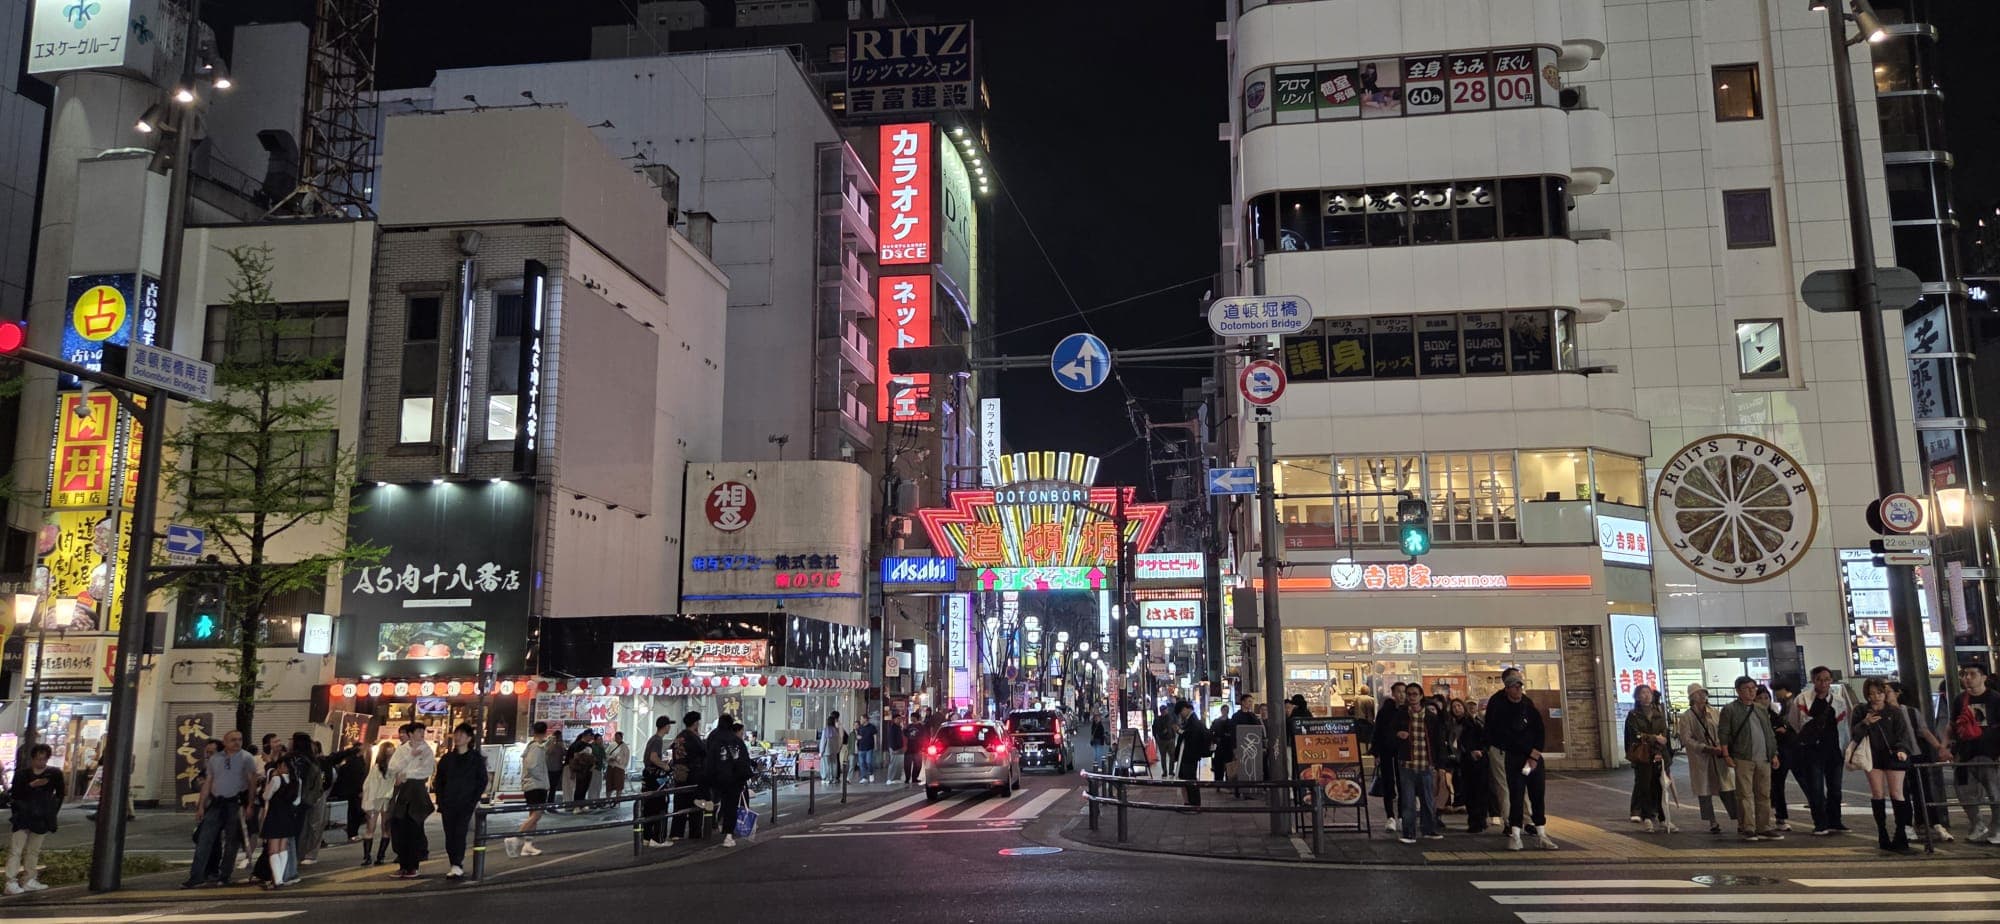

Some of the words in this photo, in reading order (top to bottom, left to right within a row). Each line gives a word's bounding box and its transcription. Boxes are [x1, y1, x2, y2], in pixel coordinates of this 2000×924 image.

[853, 24, 968, 62] RITZ
[852, 60, 967, 82] リッツマンション
[1407, 62, 1443, 79] 全身
[1451, 58, 1485, 74] もみ
[1495, 55, 1529, 72] ほぐし
[1278, 78, 1311, 92] アロマ
[1408, 86, 1442, 106] 60分
[1453, 80, 1488, 104] 28
[850, 84, 968, 112] 吉富建設
[890, 129, 919, 241] カラオケ
[84, 288, 117, 337] 占
[1223, 300, 1299, 320] 道頓堀橋
[1219, 320, 1269, 332] Dotombori
[1271, 318, 1302, 331] Bridge
[1660, 440, 1719, 499] FRUITS
[1736, 440, 1807, 495] TOWER
[996, 491, 1088, 505] DOTONBORI
[963, 521, 1118, 563] 道頓堀
[1612, 530, 1645, 552] 吉野家
[1673, 536, 1801, 579] フルーツタワー
[352, 560, 522, 595] A5肉十八番店
[910, 558, 946, 583] Asahi
[1363, 565, 1431, 588] 吉野家
